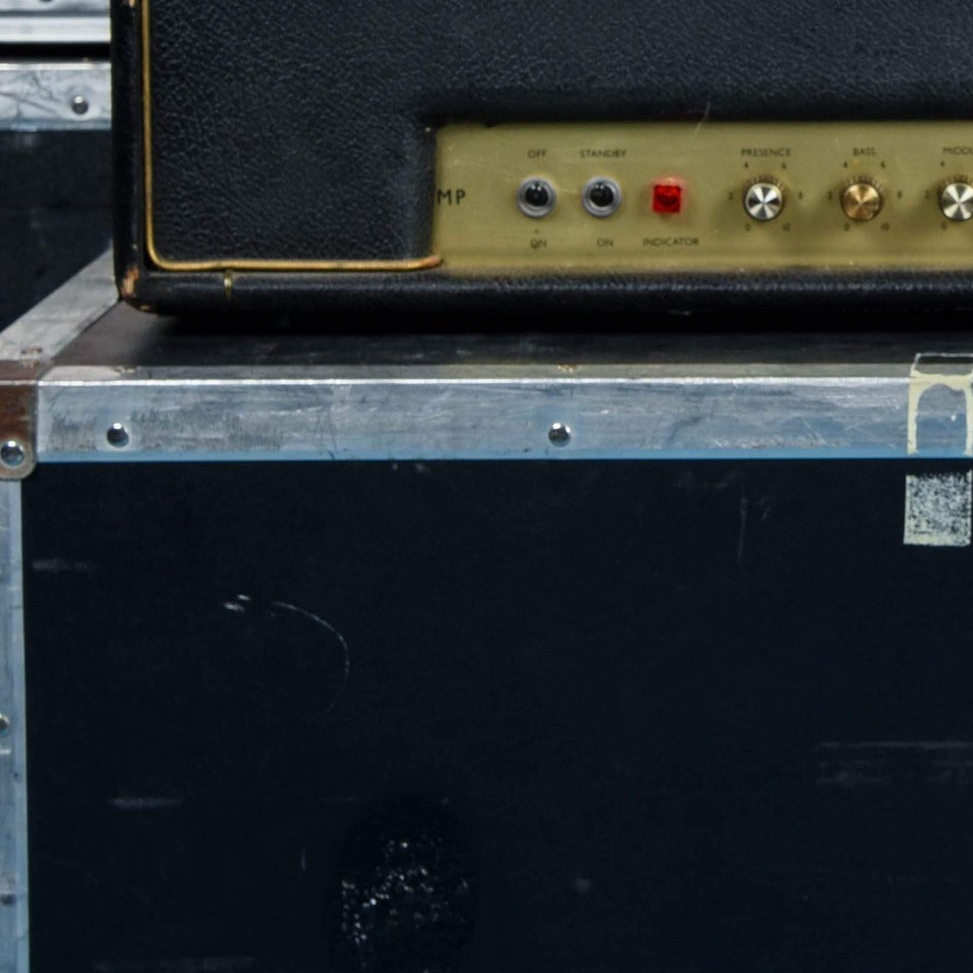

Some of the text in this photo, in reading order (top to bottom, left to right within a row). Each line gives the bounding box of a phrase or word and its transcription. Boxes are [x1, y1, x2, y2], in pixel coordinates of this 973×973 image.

[526, 148, 547, 159] OFF
[579, 148, 628, 159] STANDBY
[740, 147, 791, 158] PRESENCE
[852, 146, 877, 157] BASS
[596, 238, 614, 248] ON
[642, 236, 700, 247] INDICATOR
